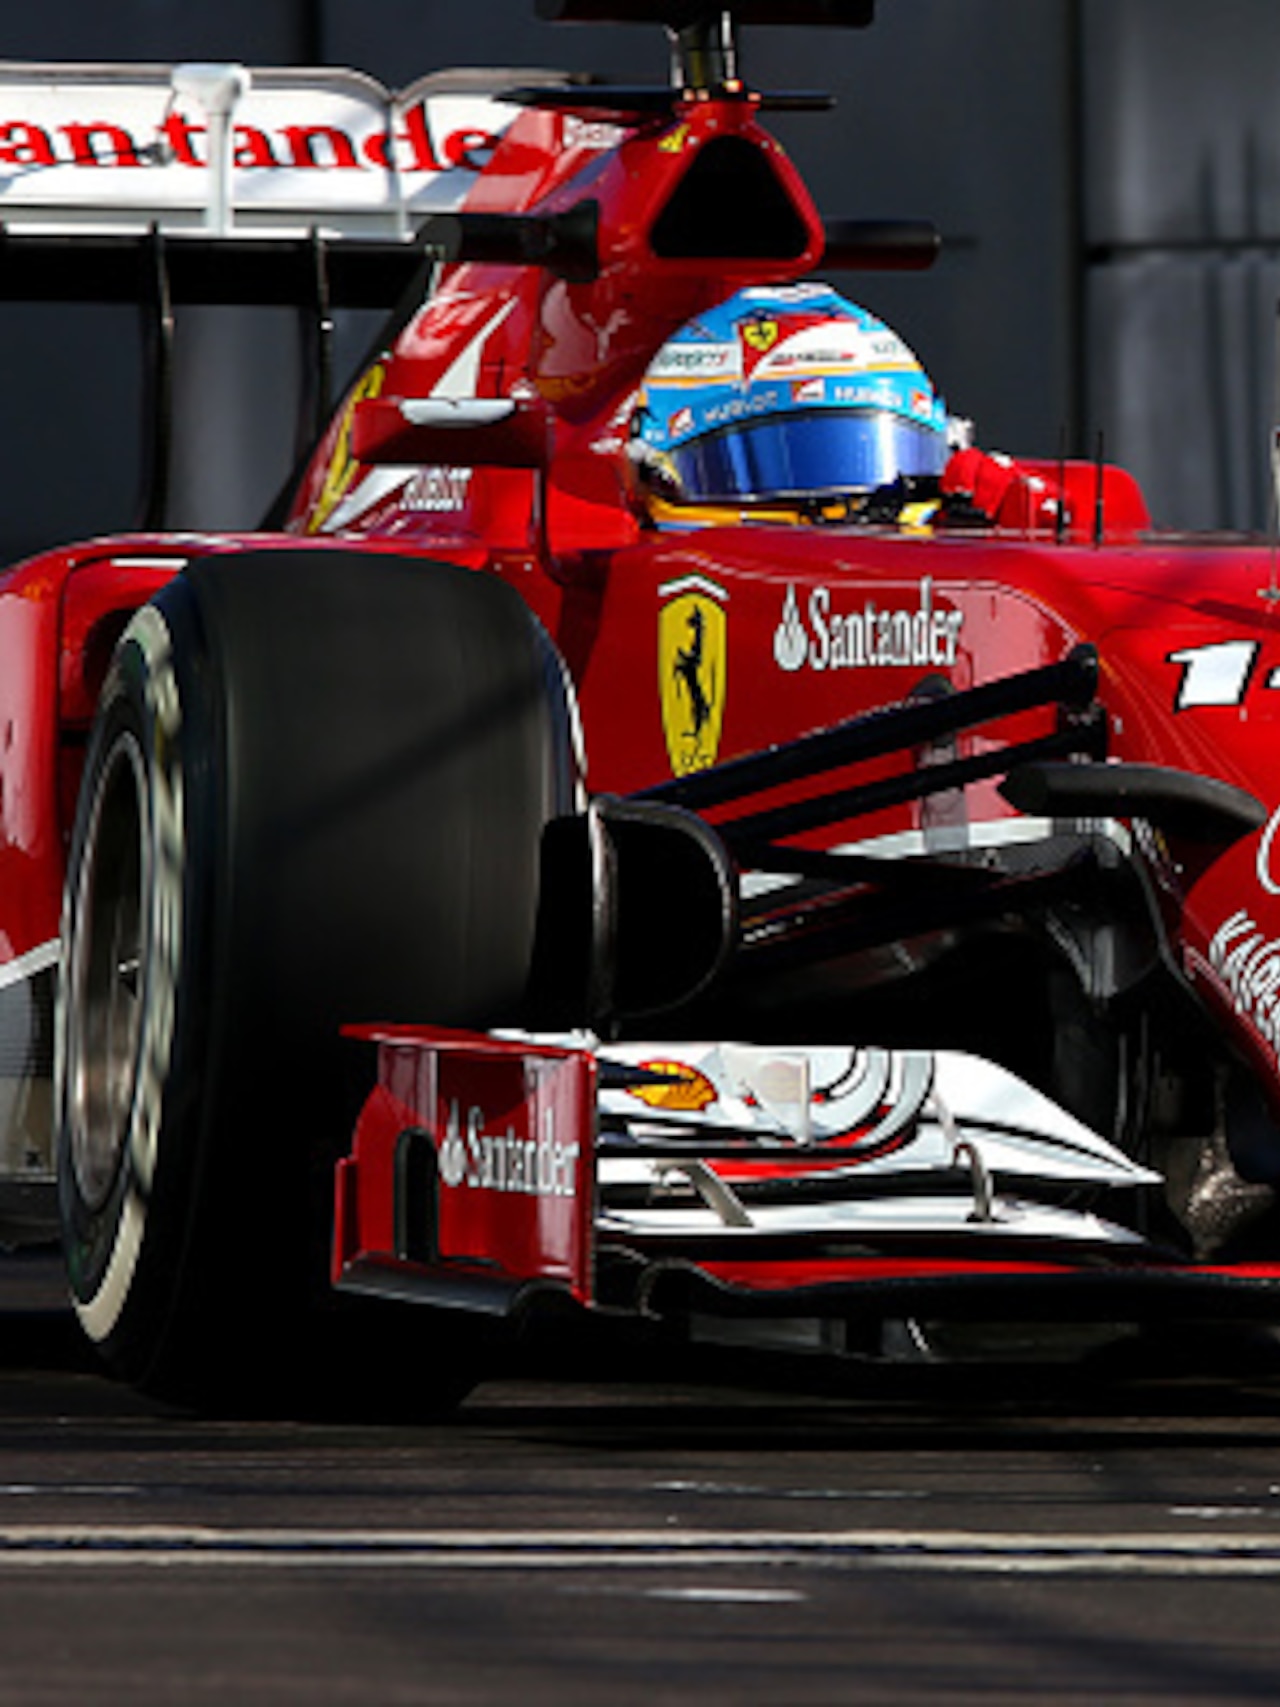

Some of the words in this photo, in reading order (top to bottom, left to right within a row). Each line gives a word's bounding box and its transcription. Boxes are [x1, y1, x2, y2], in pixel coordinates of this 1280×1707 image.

[0, 99, 498, 172] antande
[808, 575, 963, 671] Santander
[466, 1105, 580, 1196] Santander
